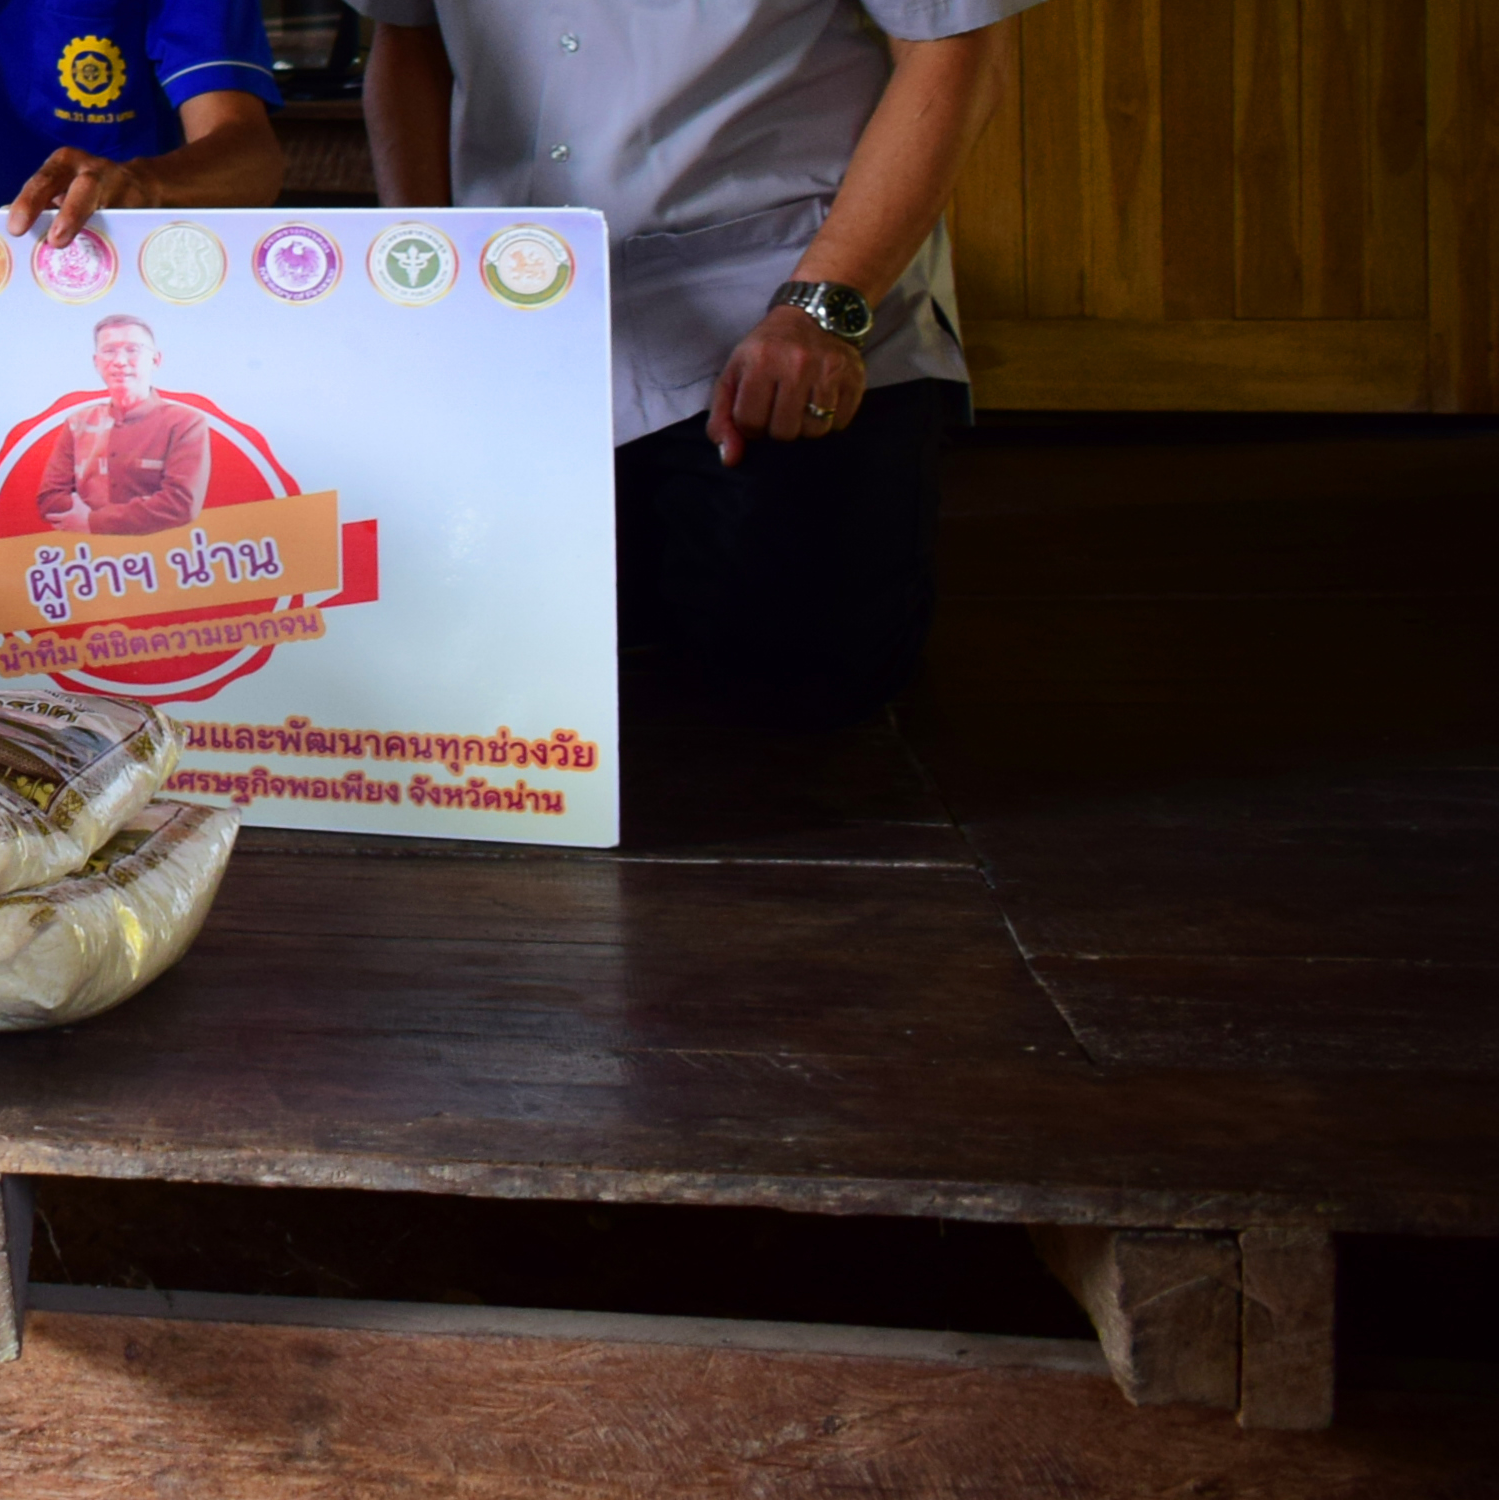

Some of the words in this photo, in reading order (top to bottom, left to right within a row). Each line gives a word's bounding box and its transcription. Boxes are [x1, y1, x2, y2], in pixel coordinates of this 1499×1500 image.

[29, 546, 154, 620] ผู้ว่าฯ
[170, 532, 280, 585] น่าน
[86, 612, 319, 662] พิชิตความยากจน
[409, 780, 564, 813] จังหวัดน่าน
